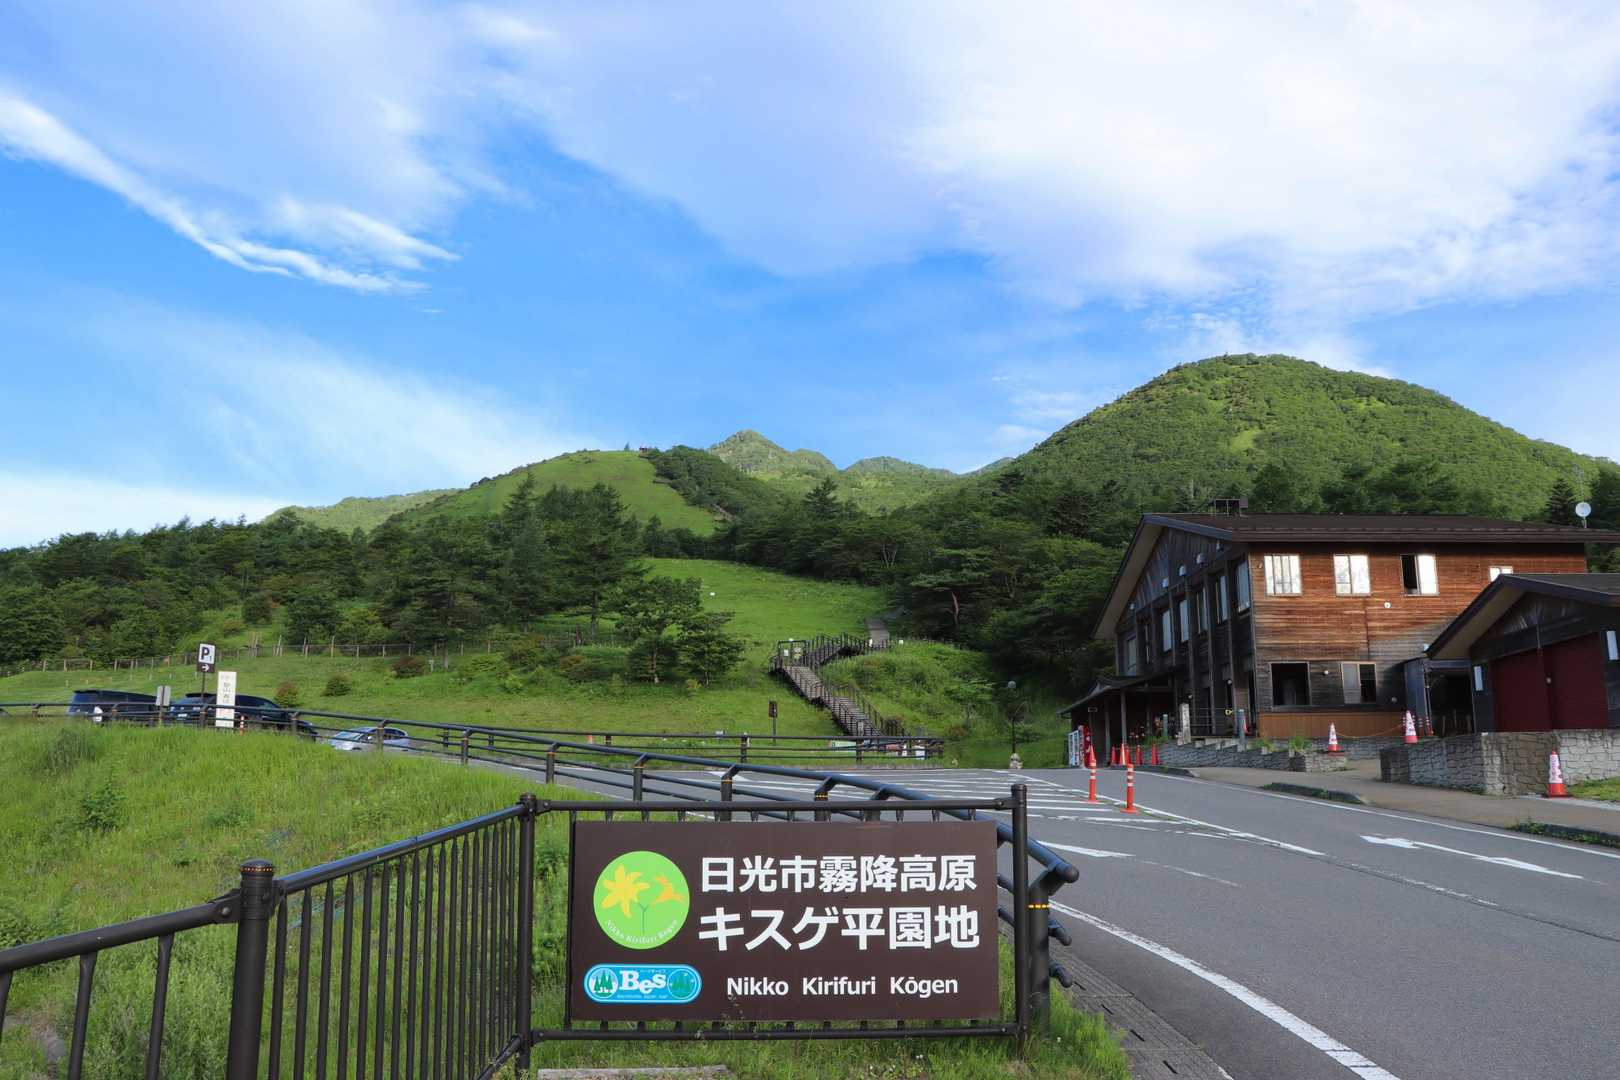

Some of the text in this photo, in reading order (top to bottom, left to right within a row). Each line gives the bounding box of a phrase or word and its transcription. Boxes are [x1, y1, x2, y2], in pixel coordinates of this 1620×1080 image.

[701, 854, 977, 894] 日光市霧降高原
[698, 905, 980, 952] キスゲ平園地
[727, 977, 789, 996] Nikko
[802, 976, 876, 996] Kirifuri
